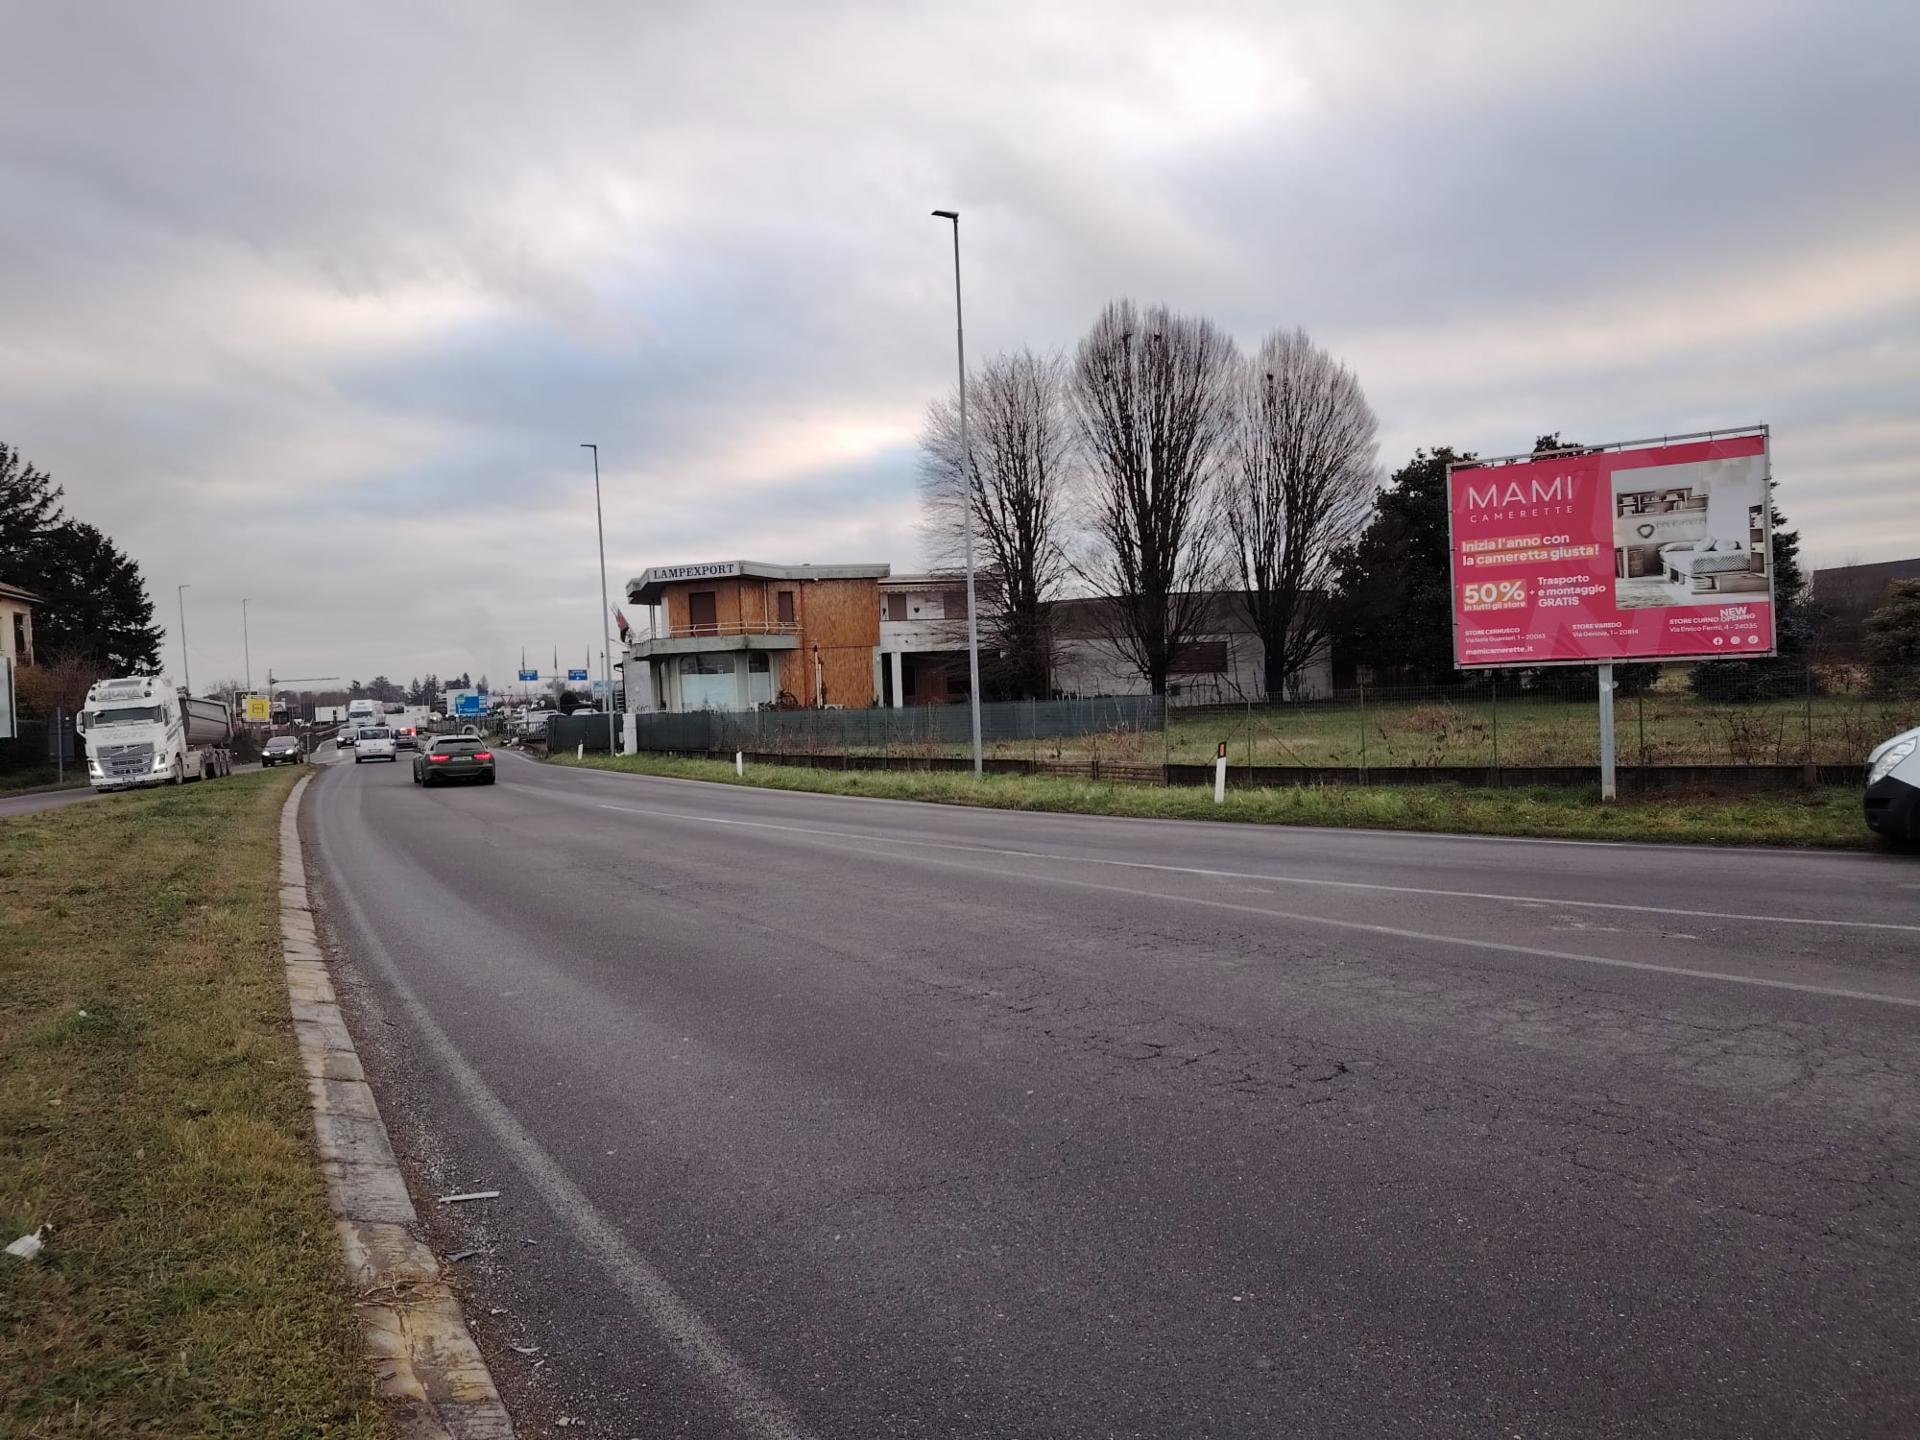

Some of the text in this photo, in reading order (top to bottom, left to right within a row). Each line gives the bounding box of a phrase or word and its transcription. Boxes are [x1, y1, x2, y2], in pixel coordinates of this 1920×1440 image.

[1469, 475, 1573, 510] MAMI
[1469, 505, 1573, 523] CAMERETTE
[1462, 534, 1570, 553] Inizia l'anno con
[1462, 544, 1600, 566] la cameretta giusta!
[653, 563, 734, 579] LAMPEXPORT
[1537, 574, 1590, 587] Trasporto
[1465, 581, 1525, 604] 50%
[1537, 584, 1606, 597] e montaggio
[1473, 602, 1491, 611] tutti
[1492, 601, 1502, 611] gli
[1503, 600, 1526, 609] store
[1538, 596, 1580, 608] GRATIS
[1692, 616, 1719, 624] CURNO
[1720, 612, 1757, 622] OPENING
[1720, 606, 1748, 617] NEW
[1465, 646, 1534, 655] mamicamerette.it
